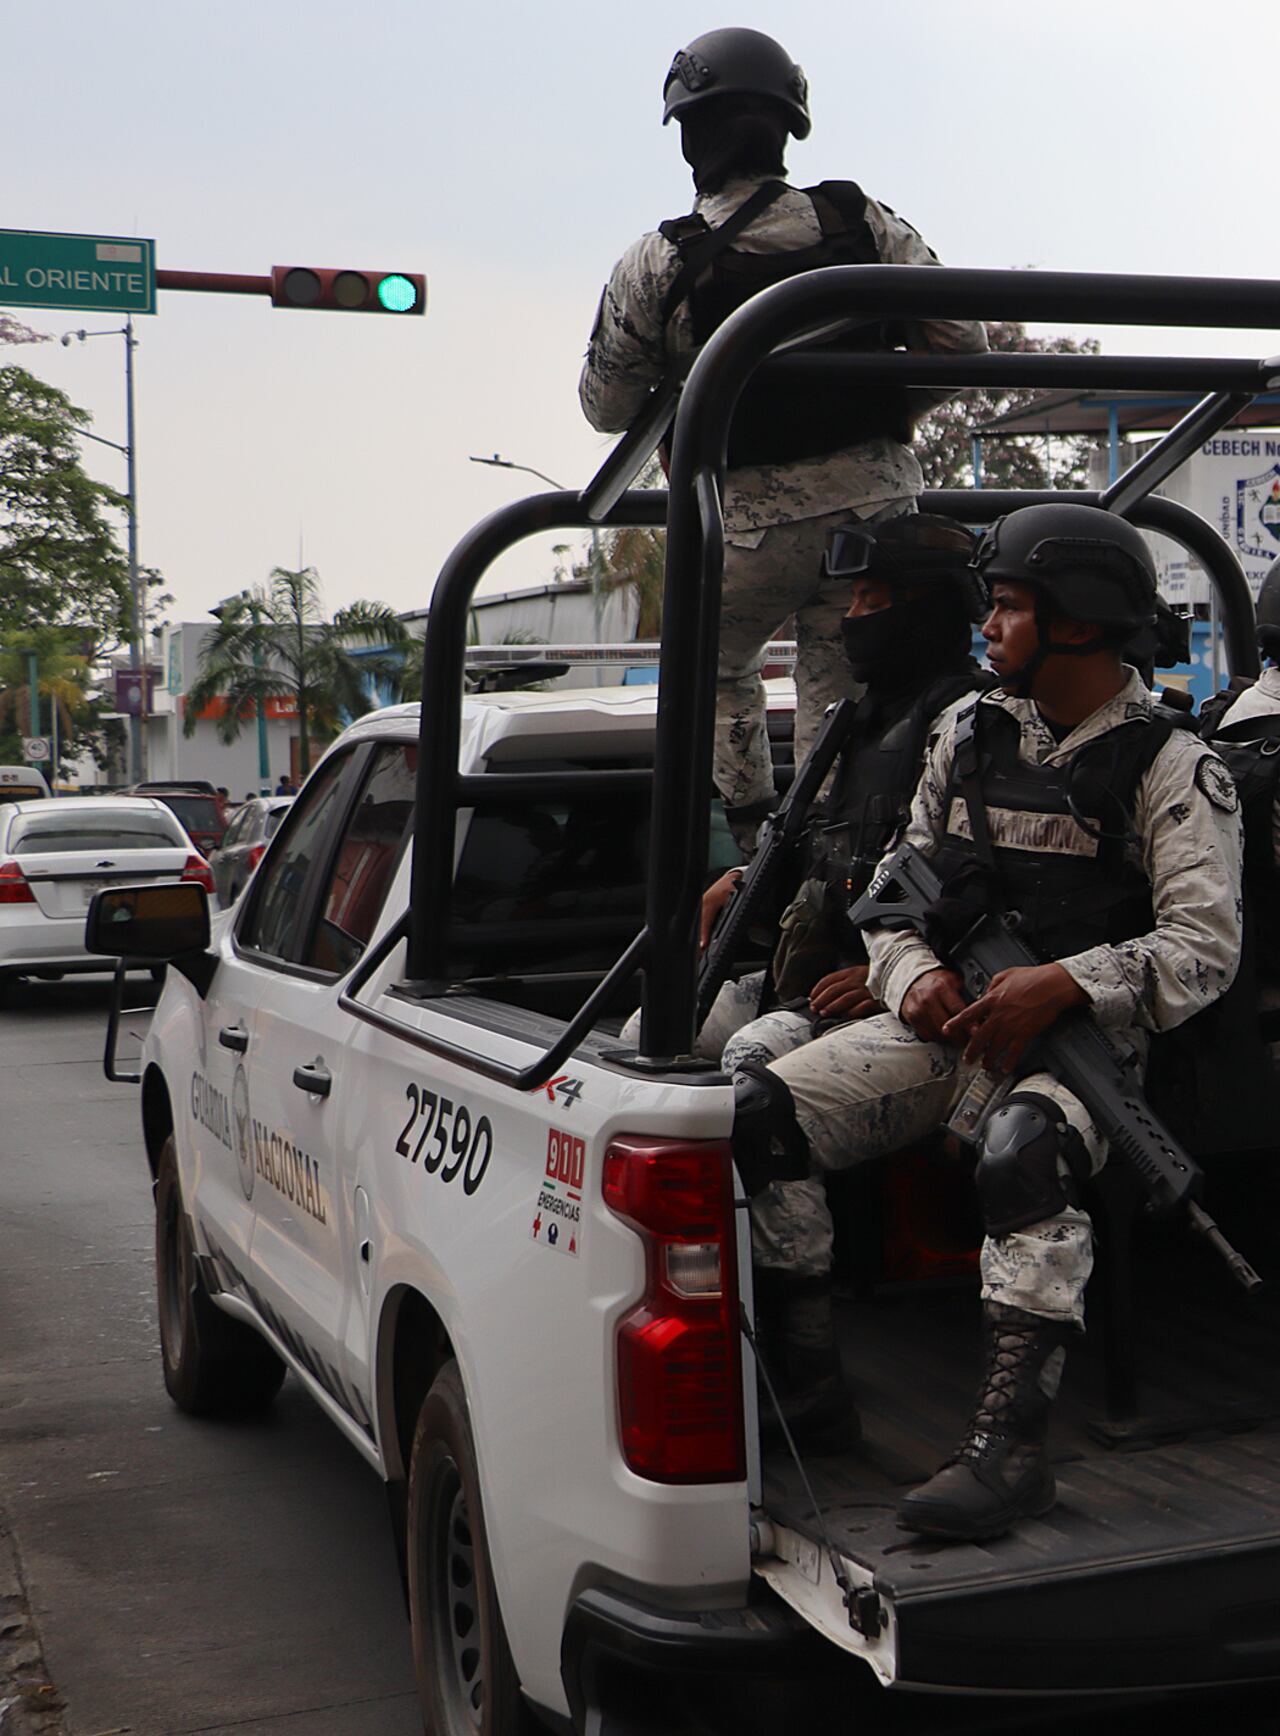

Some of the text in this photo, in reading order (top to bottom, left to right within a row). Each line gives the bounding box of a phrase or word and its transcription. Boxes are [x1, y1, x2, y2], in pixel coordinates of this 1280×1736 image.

[25, 268, 144, 293] ORIENTE
[1202, 440, 1260, 457] CEBECH
[395, 1082, 493, 1196] 27590
[252, 1118, 327, 1225] NACIONAL
[548, 1136, 583, 1182] 911
[537, 1191, 581, 1223] EMERGENCIAS
